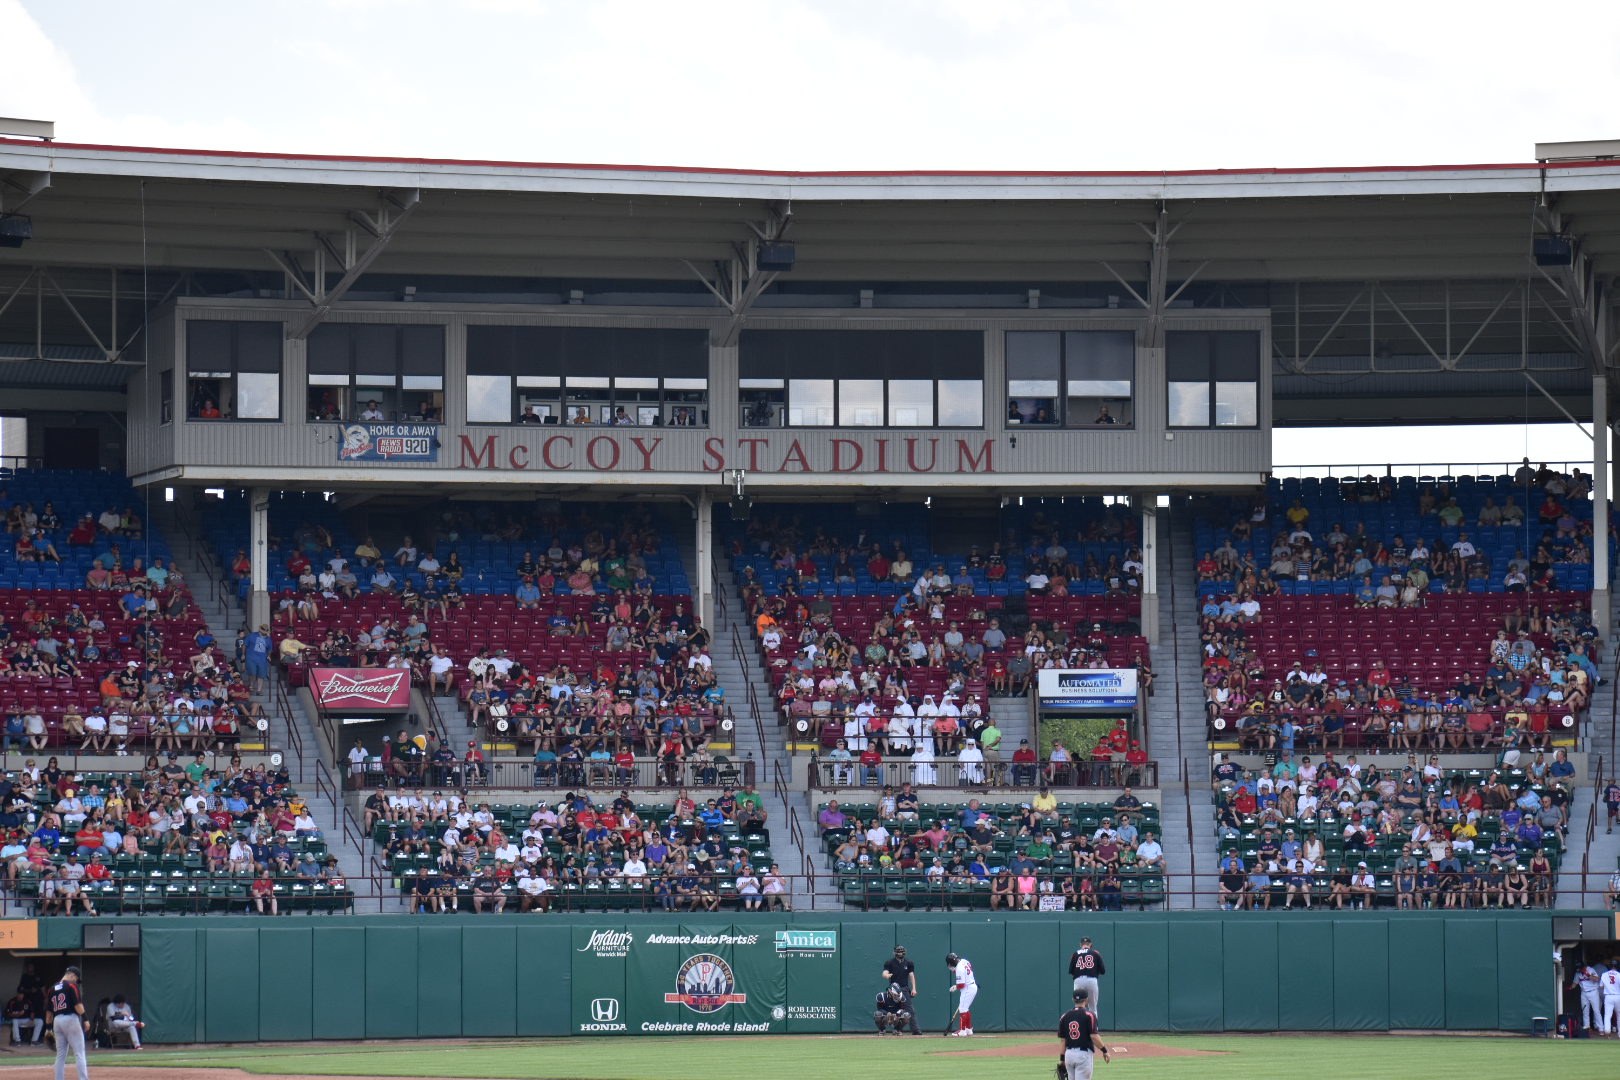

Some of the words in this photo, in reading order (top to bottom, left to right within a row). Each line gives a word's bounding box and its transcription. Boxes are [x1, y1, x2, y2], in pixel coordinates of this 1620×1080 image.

[370, 425, 394, 436] HOME
[397, 425, 409, 436] OR
[412, 425, 435, 436] AWAY
[406, 440, 428, 453] 920
[457, 434, 663, 471] McCOY
[702, 437, 996, 472] STADIUM
[320, 681, 398, 694] Budweiser
[577, 930, 632, 951] Jordan's
[646, 934, 690, 944] Advance
[691, 934, 719, 944] Auto
[719, 934, 748, 944] Parts
[778, 932, 832, 946] Amica
[1076, 955, 1094, 968] 48
[683, 956, 704, 971] YEARS
[707, 956, 732, 984] TOGETHER
[700, 964, 711, 982] P
[52, 993, 66, 1012] 12
[641, 1022, 694, 1032] Celebrate
[696, 1022, 730, 1032] Rhode
[734, 1022, 770, 1032] Island!
[1069, 1020, 1080, 1040] 8
